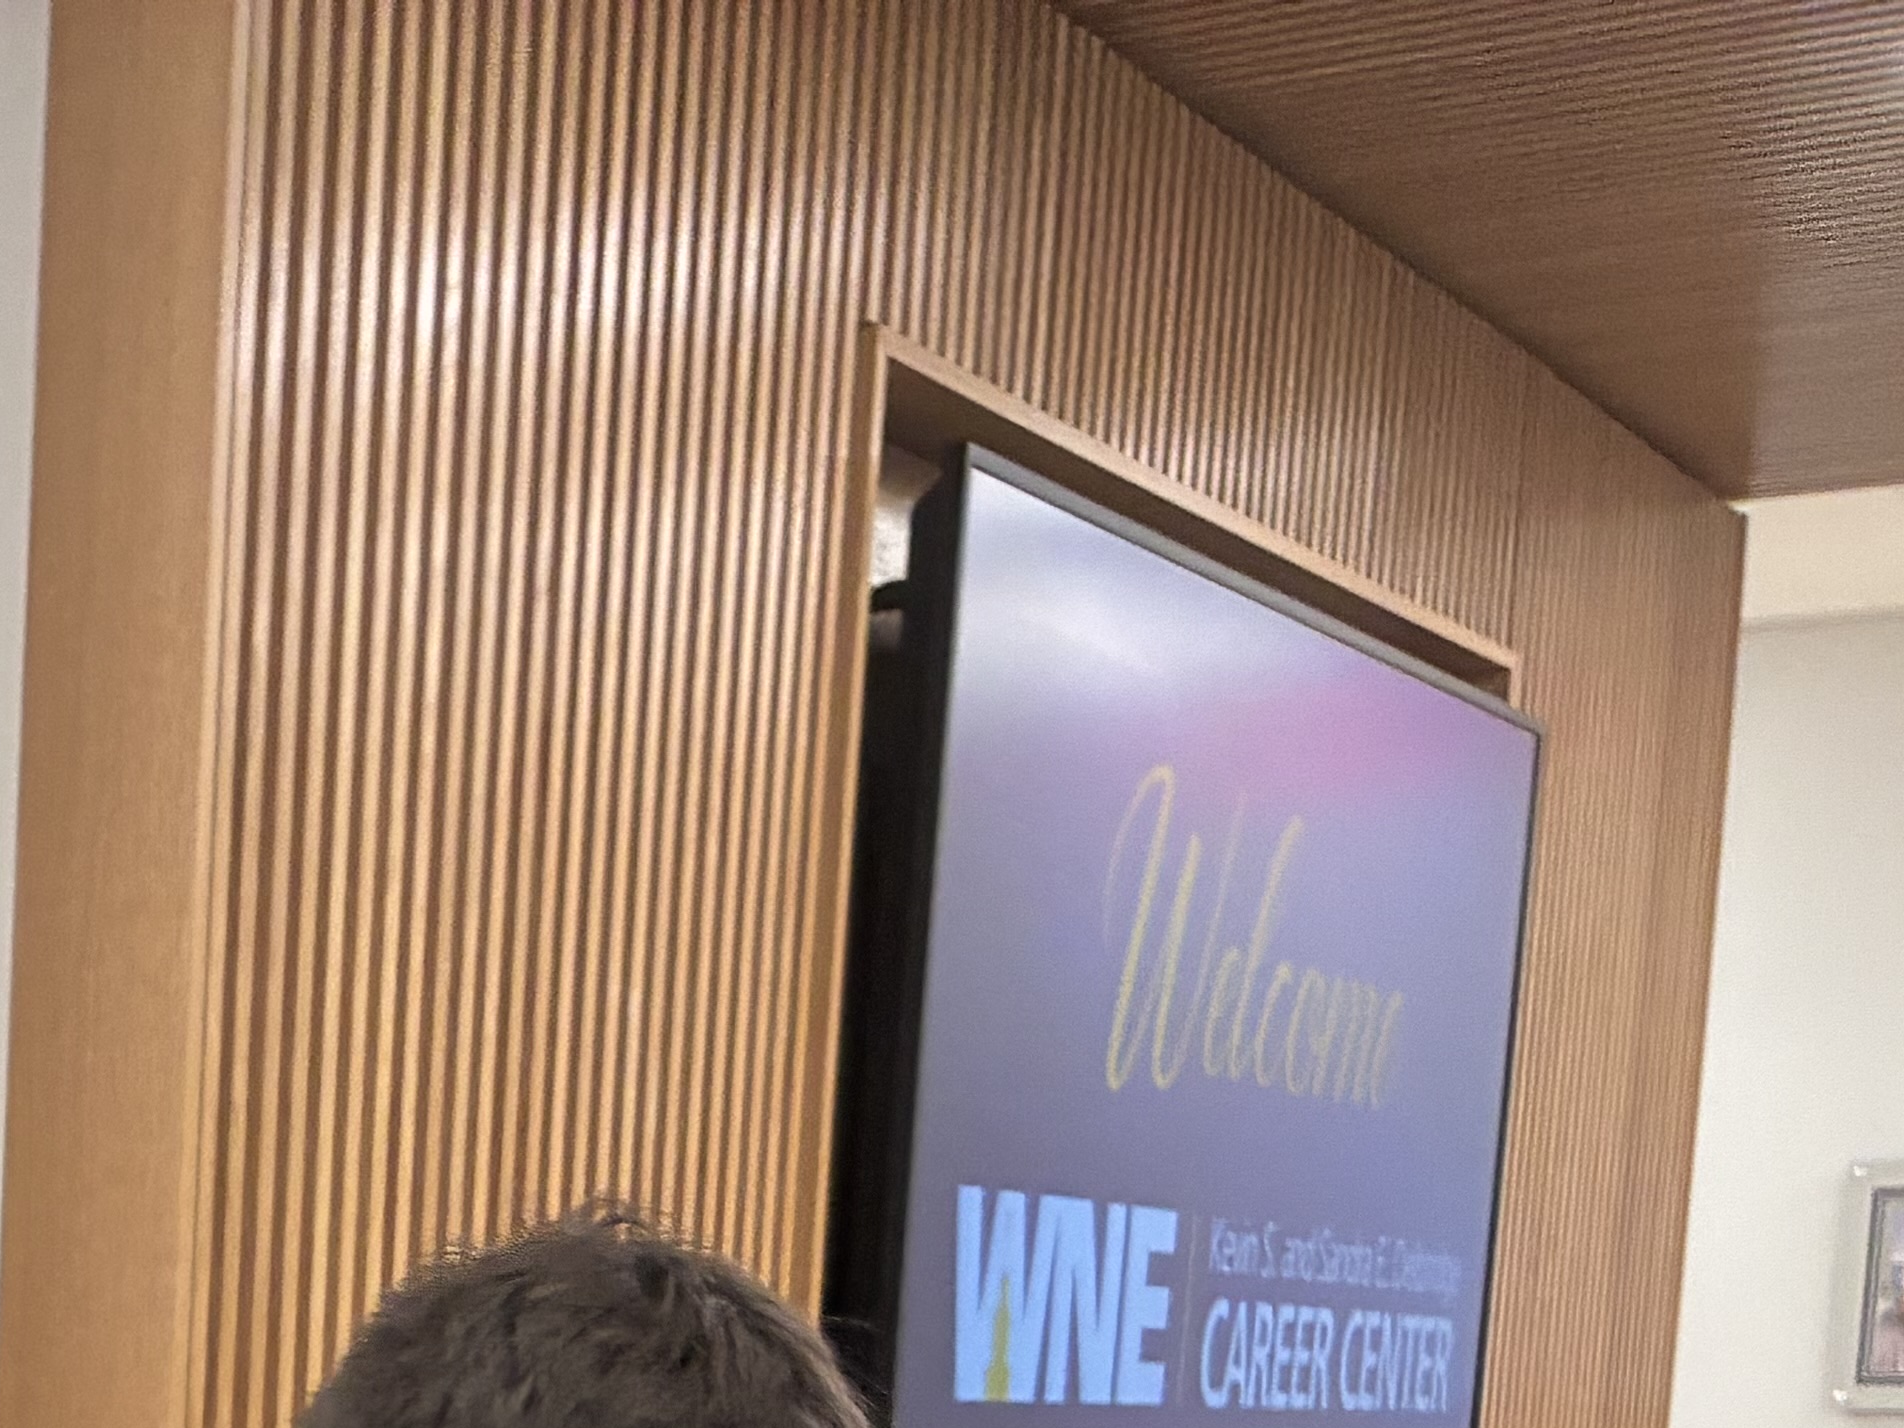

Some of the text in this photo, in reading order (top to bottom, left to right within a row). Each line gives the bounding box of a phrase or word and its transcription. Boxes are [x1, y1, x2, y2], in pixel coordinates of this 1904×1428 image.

[954, 1184, 1178, 1407] WNE
[1200, 1297, 1453, 1413] CAREER CENTER
